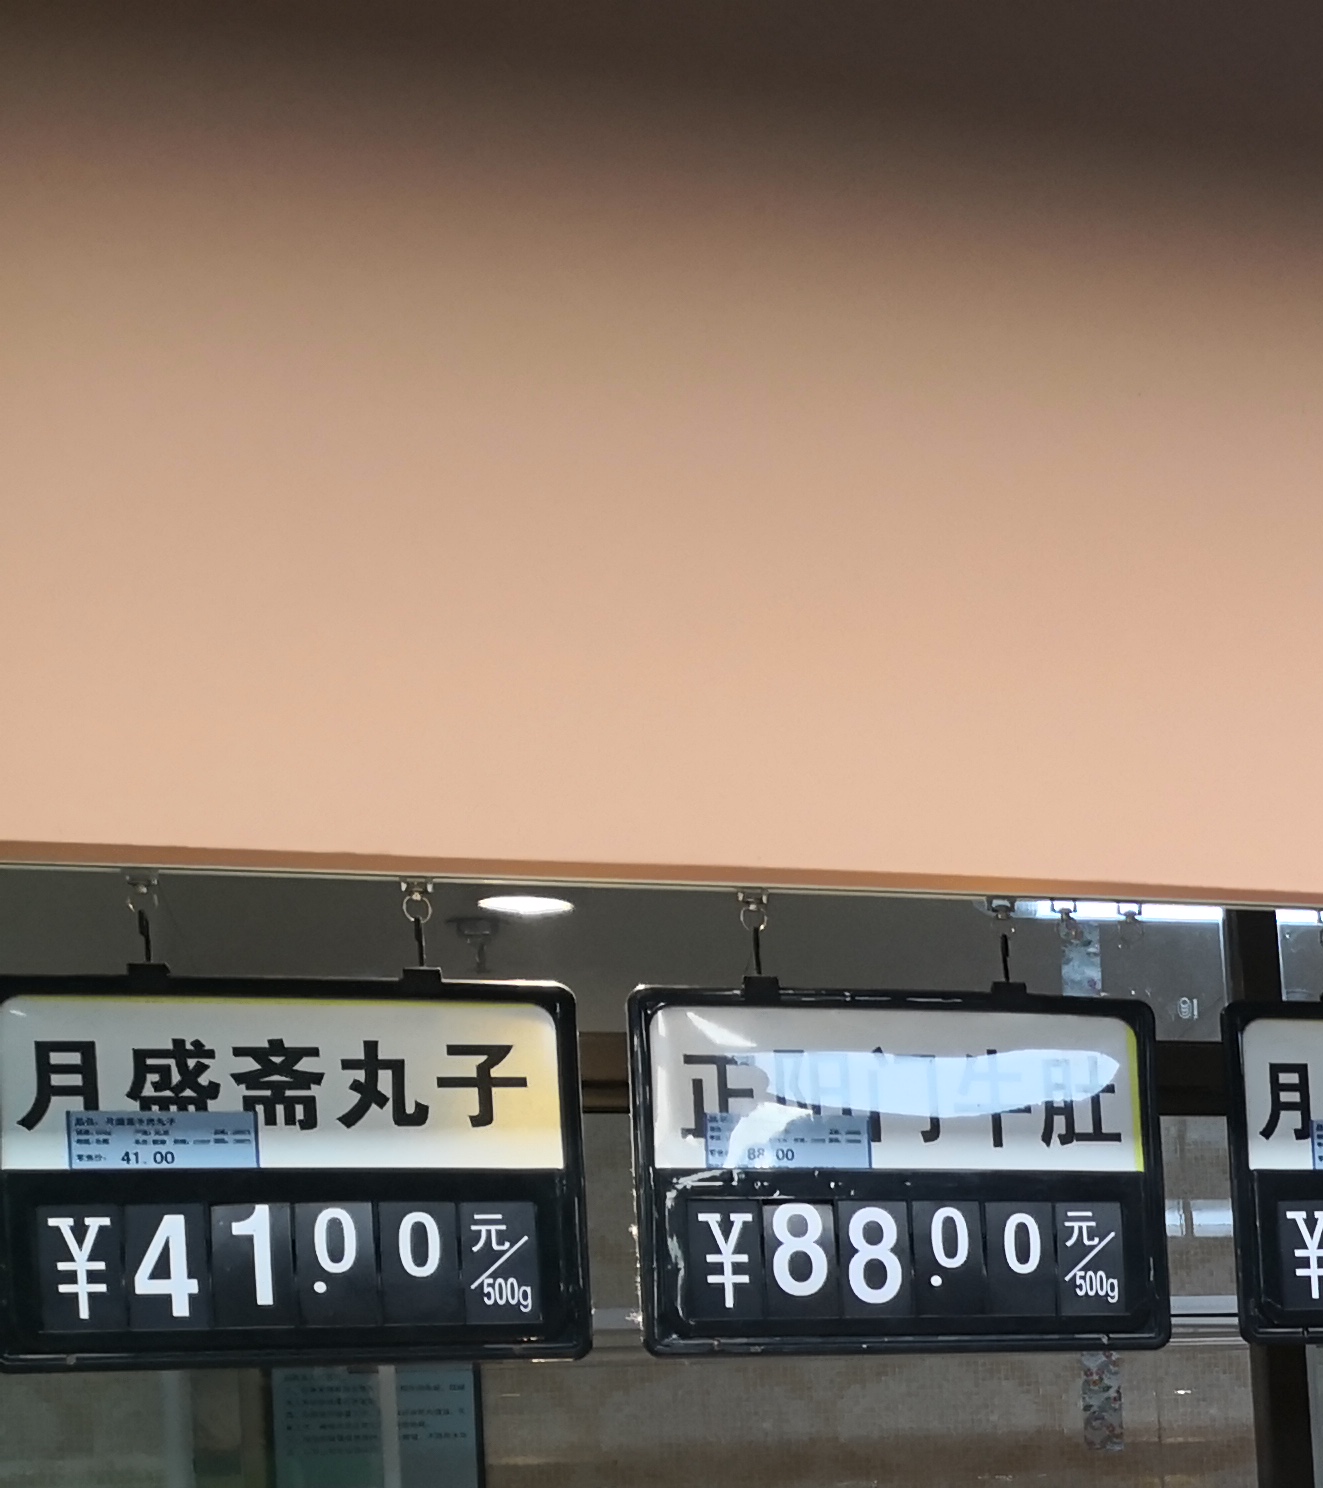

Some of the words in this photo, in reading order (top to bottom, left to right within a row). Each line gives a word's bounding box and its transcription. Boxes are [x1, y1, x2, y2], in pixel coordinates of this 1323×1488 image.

[16, 1038, 528, 1131] 月盛斋丸子
[681, 1047, 1122, 1148] 正阳门牛肚
[121, 1150, 175, 1164] 41.00
